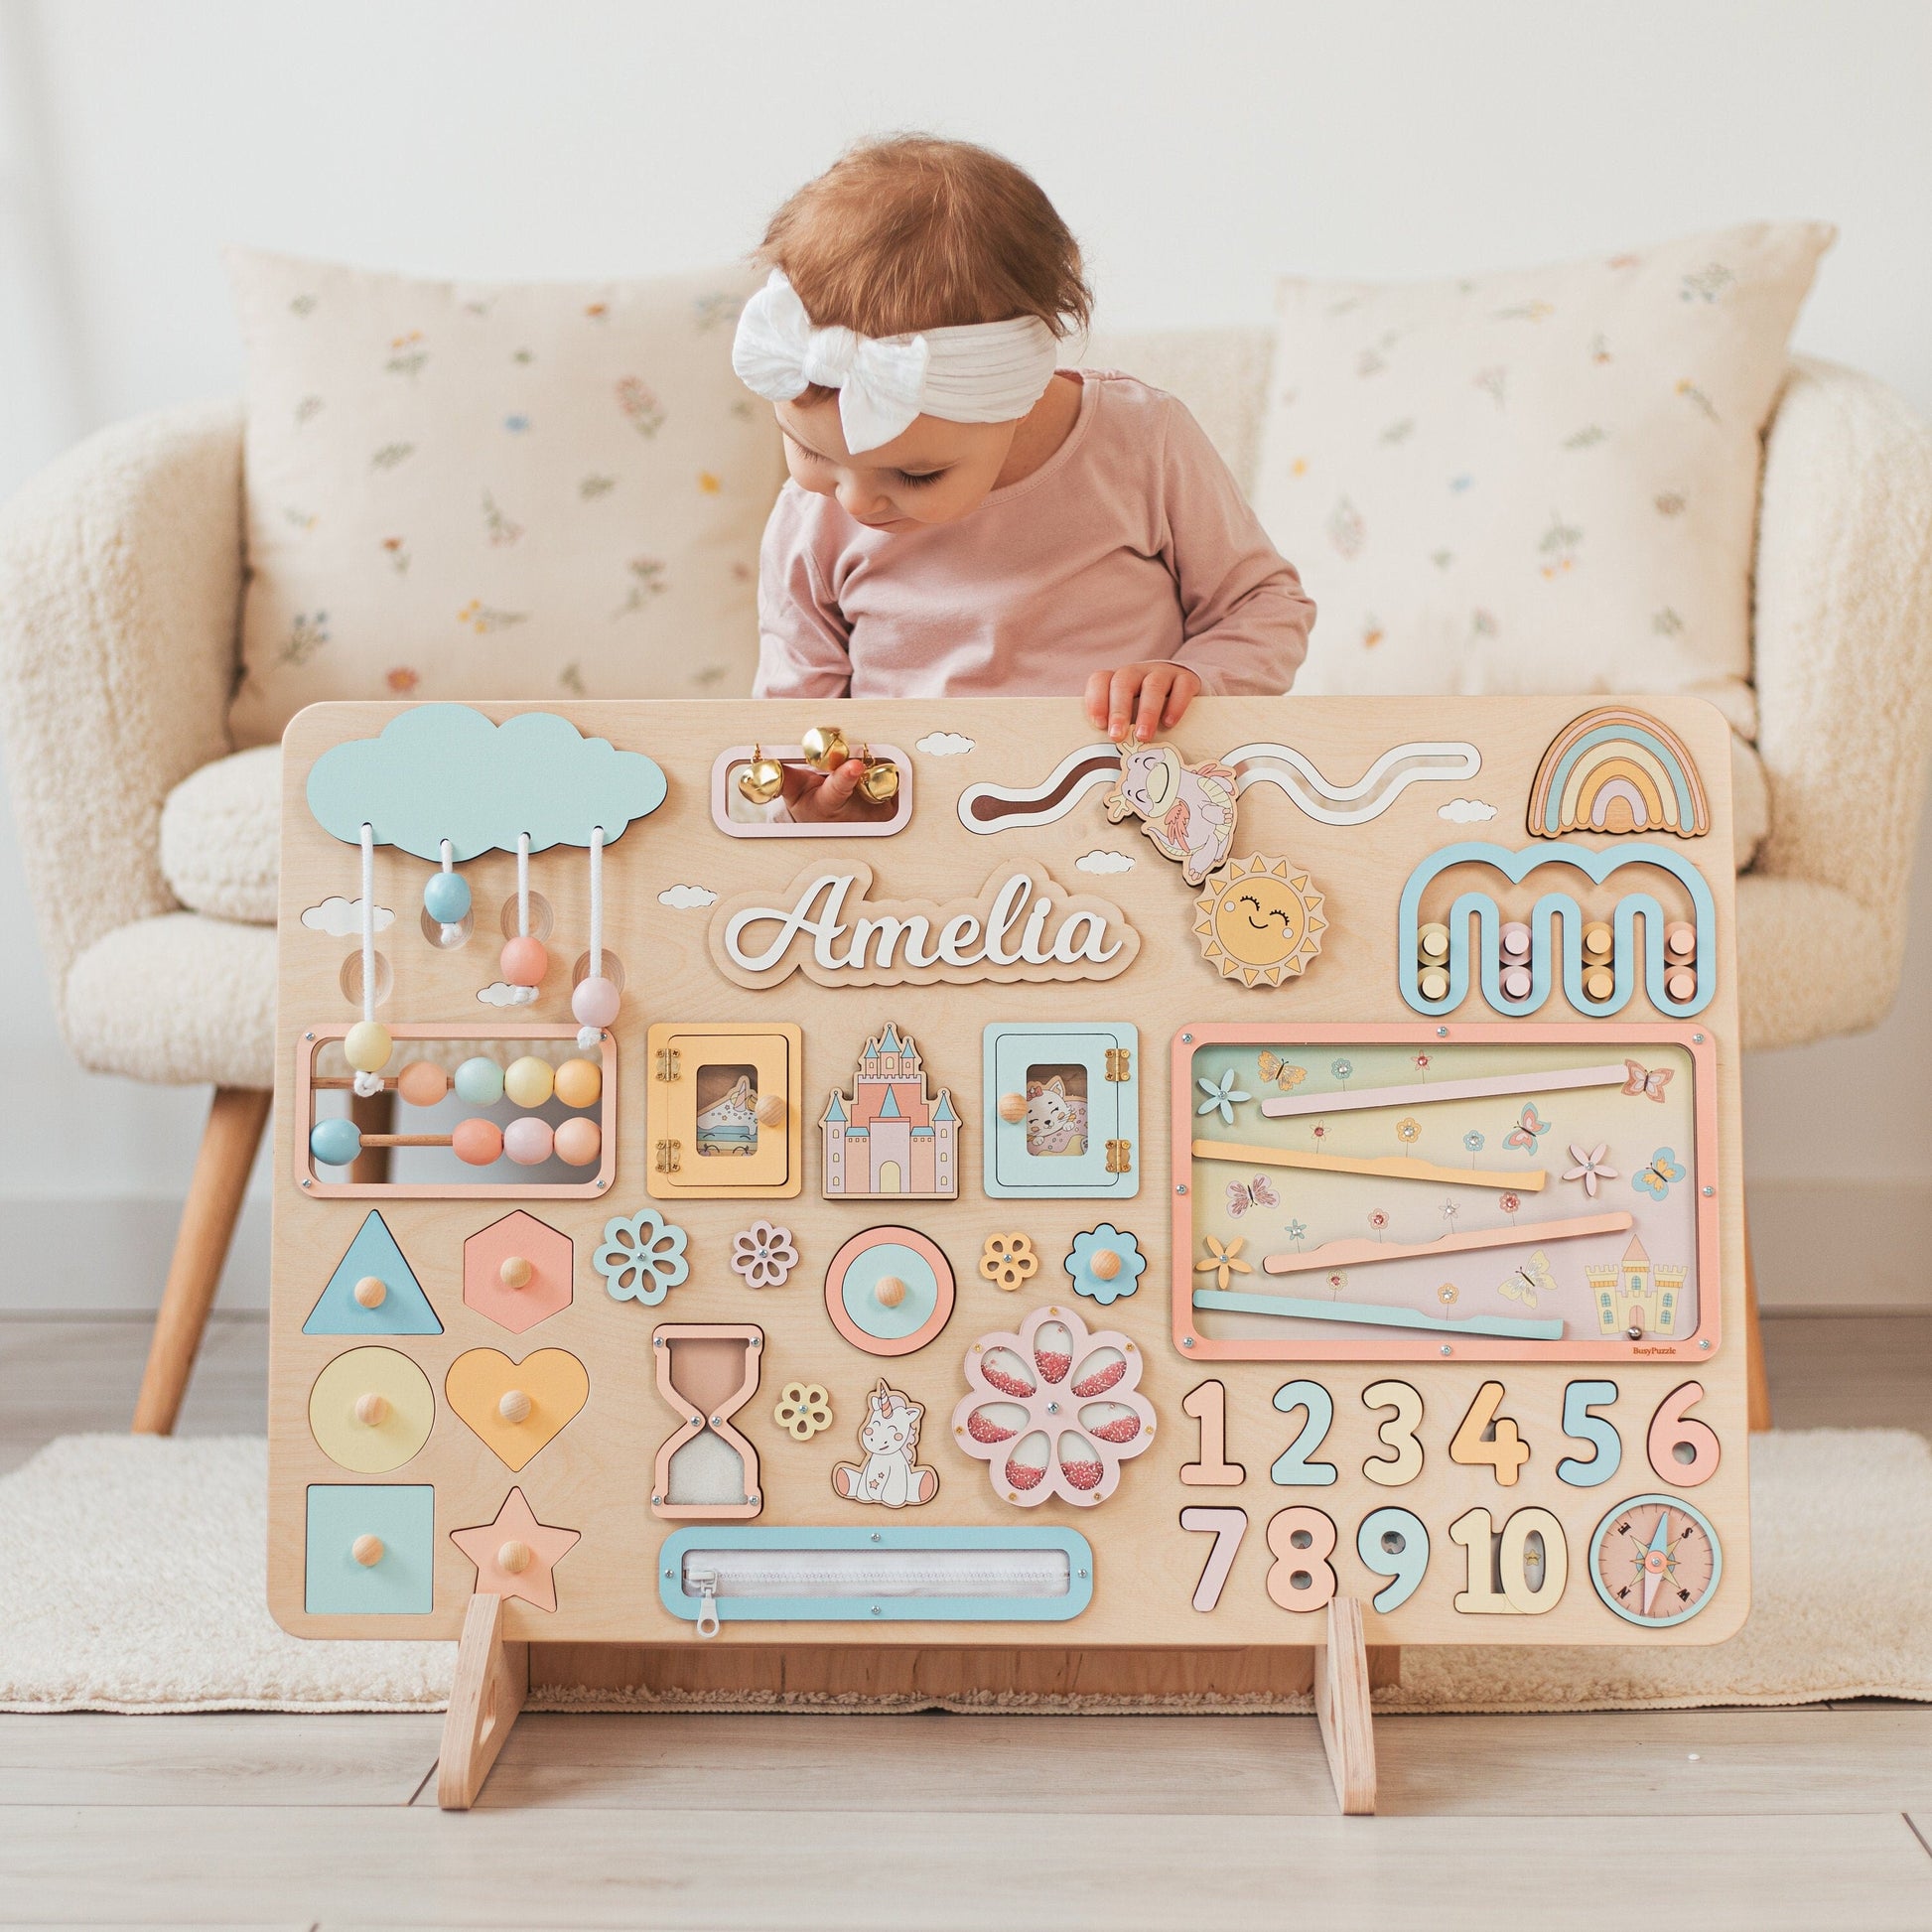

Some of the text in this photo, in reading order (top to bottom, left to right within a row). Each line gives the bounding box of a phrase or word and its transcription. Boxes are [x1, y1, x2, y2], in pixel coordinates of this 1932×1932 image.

[726, 874, 1123, 971] Amelia
[1632, 1347, 1677, 1356] BusyPuzzle
[1179, 1379, 1721, 1487] 1 2 3 4 5 6
[1617, 1522, 1631, 1535] E
[1681, 1527, 1693, 1539] S
[1179, 1505, 1569, 1614] 7 8 9 10
[1616, 1586, 1631, 1599] N
[1677, 1588, 1691, 1602] W
